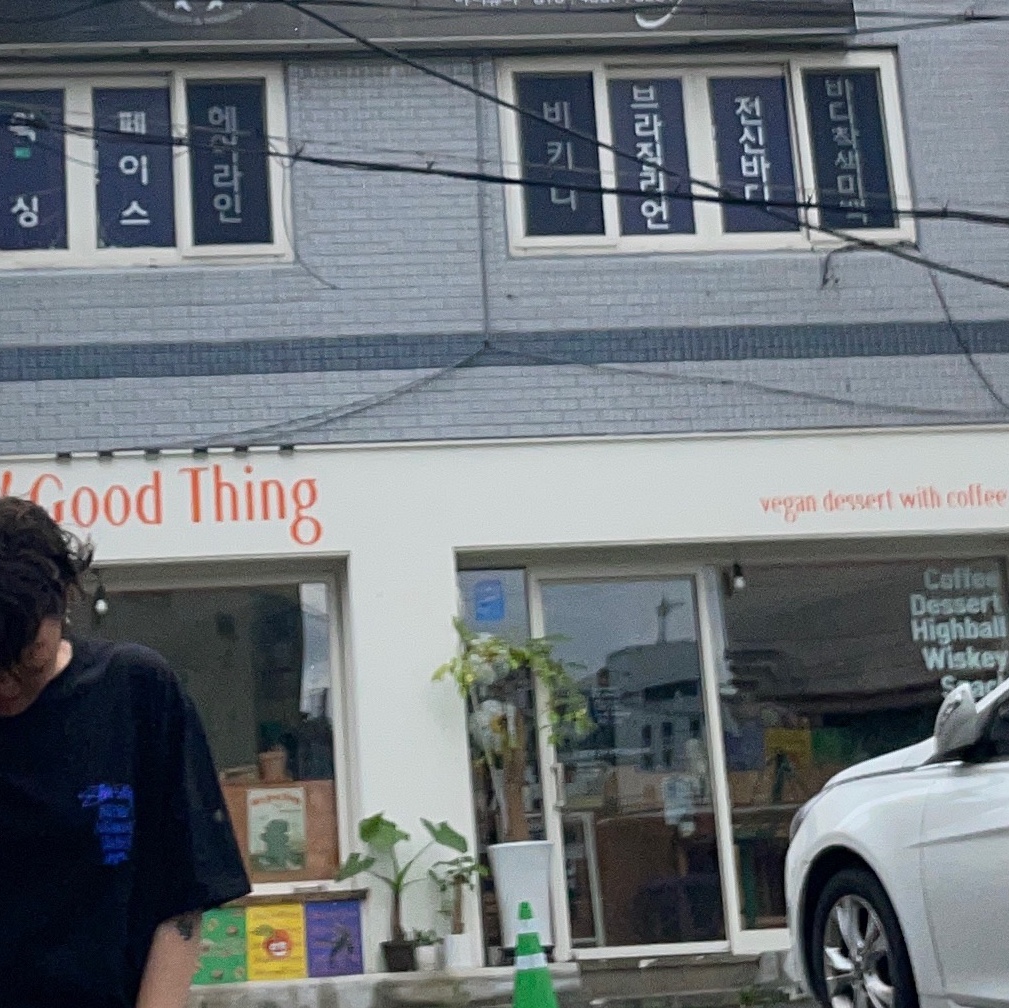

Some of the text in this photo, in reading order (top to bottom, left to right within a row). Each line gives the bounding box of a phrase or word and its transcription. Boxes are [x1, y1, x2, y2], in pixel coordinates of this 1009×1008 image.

[119, 110, 151, 226] 페이스
[542, 101, 577, 212] 비키니
[29, 470, 163, 528] Good
[179, 463, 323, 545] Thing
[759, 483, 1007, 523] vegan dessert with coffee
[910, 593, 1002, 615] Dessert
[911, 615, 1007, 644] Highball
